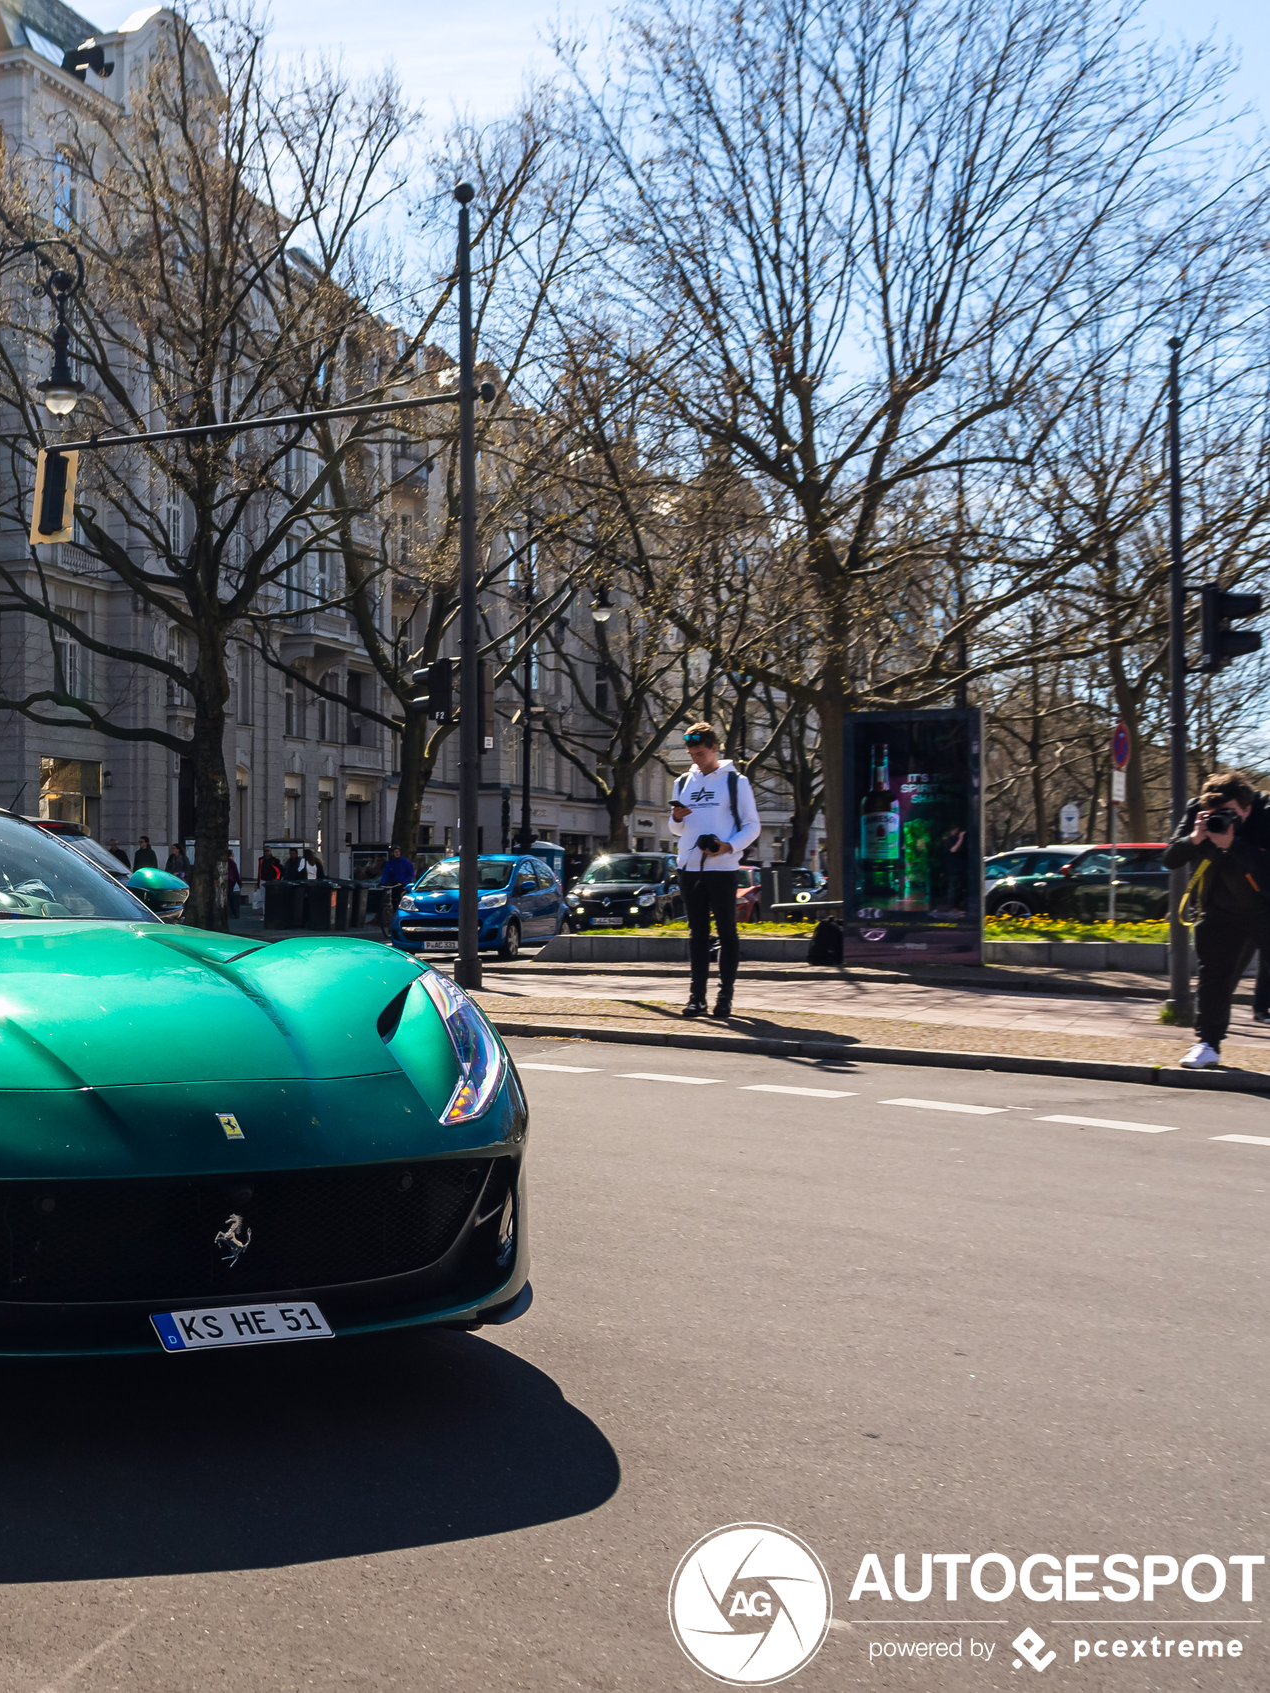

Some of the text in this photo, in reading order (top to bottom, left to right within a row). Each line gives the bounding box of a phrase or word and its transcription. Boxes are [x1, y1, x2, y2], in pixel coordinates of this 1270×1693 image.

[900, 783, 939, 793] SPIRIT
[179, 1307, 322, 1341] KS HE 51
[168, 1335, 178, 1345] D
